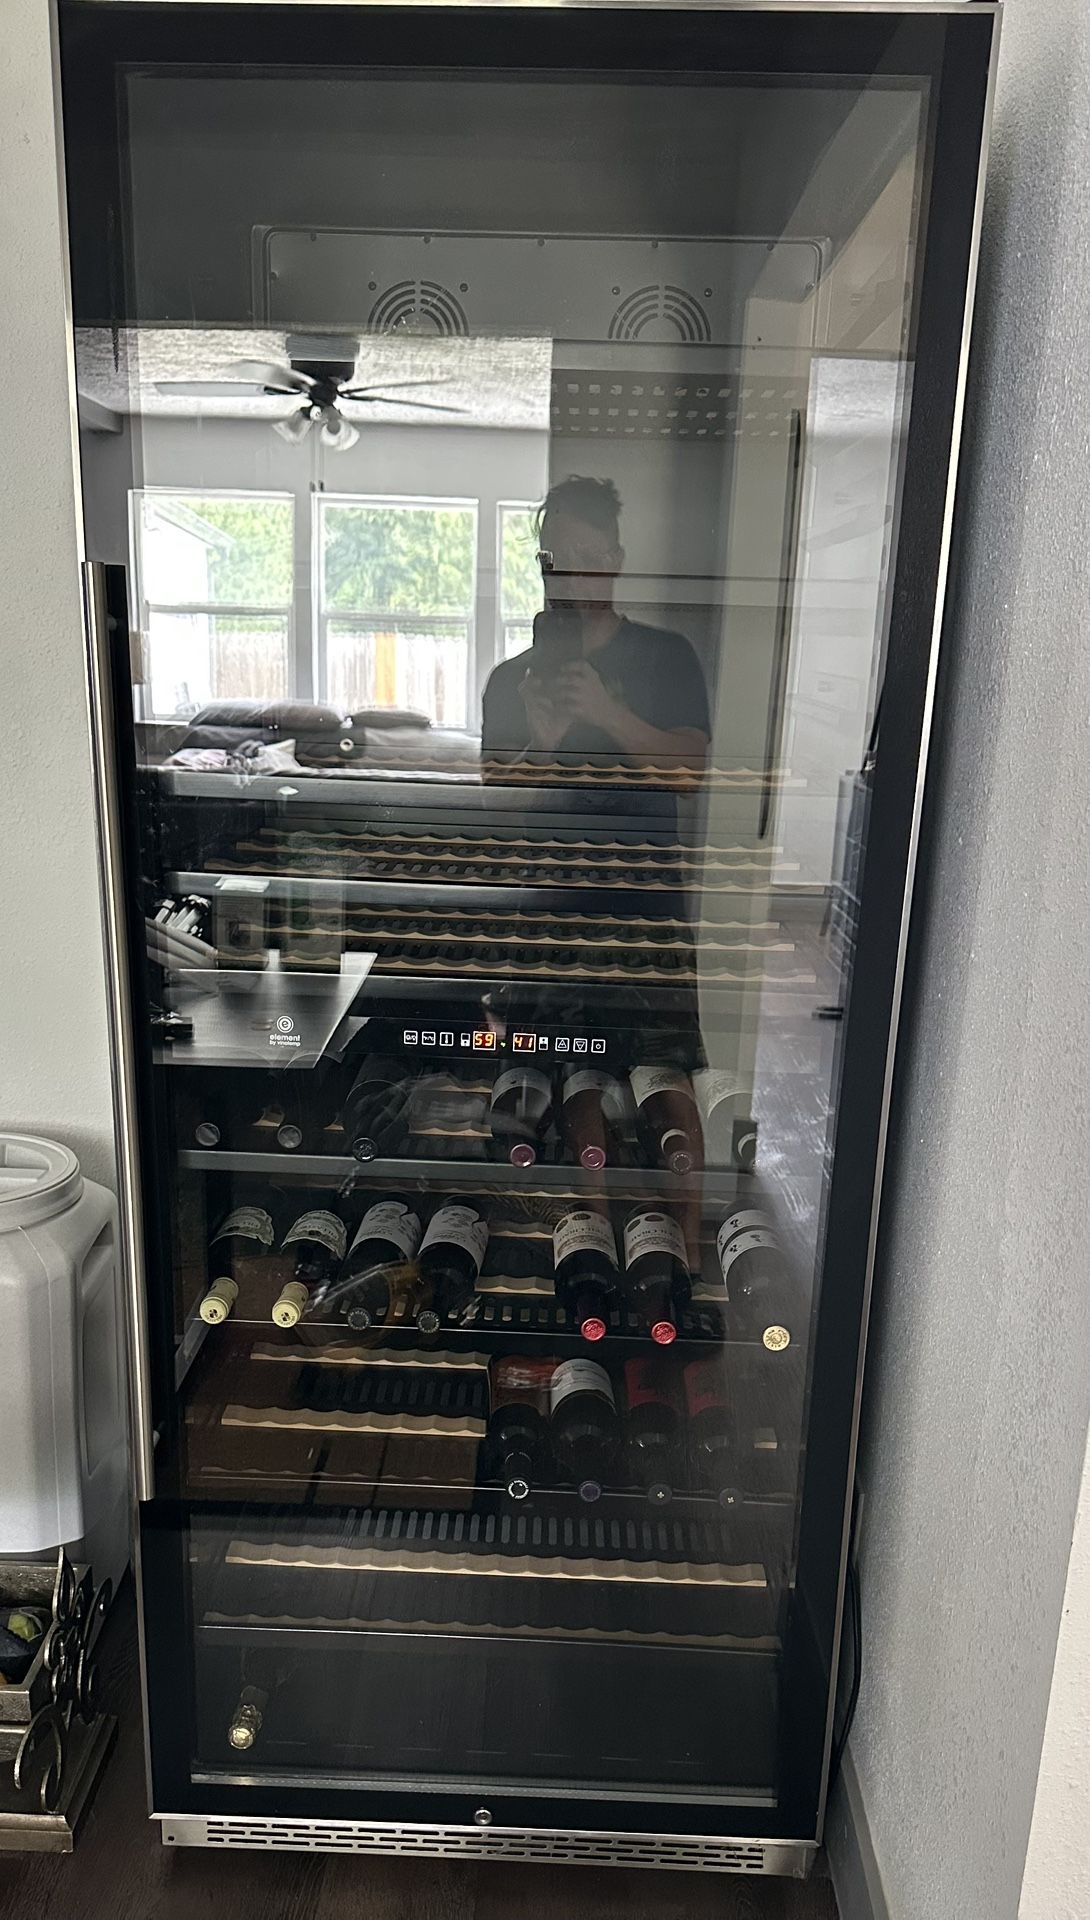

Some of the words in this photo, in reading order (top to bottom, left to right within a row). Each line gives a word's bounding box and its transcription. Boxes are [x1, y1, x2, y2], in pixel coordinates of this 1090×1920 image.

[269, 1034, 301, 1042] element
[475, 1033, 494, 1047] 59
[514, 1036, 534, 1048] 41
